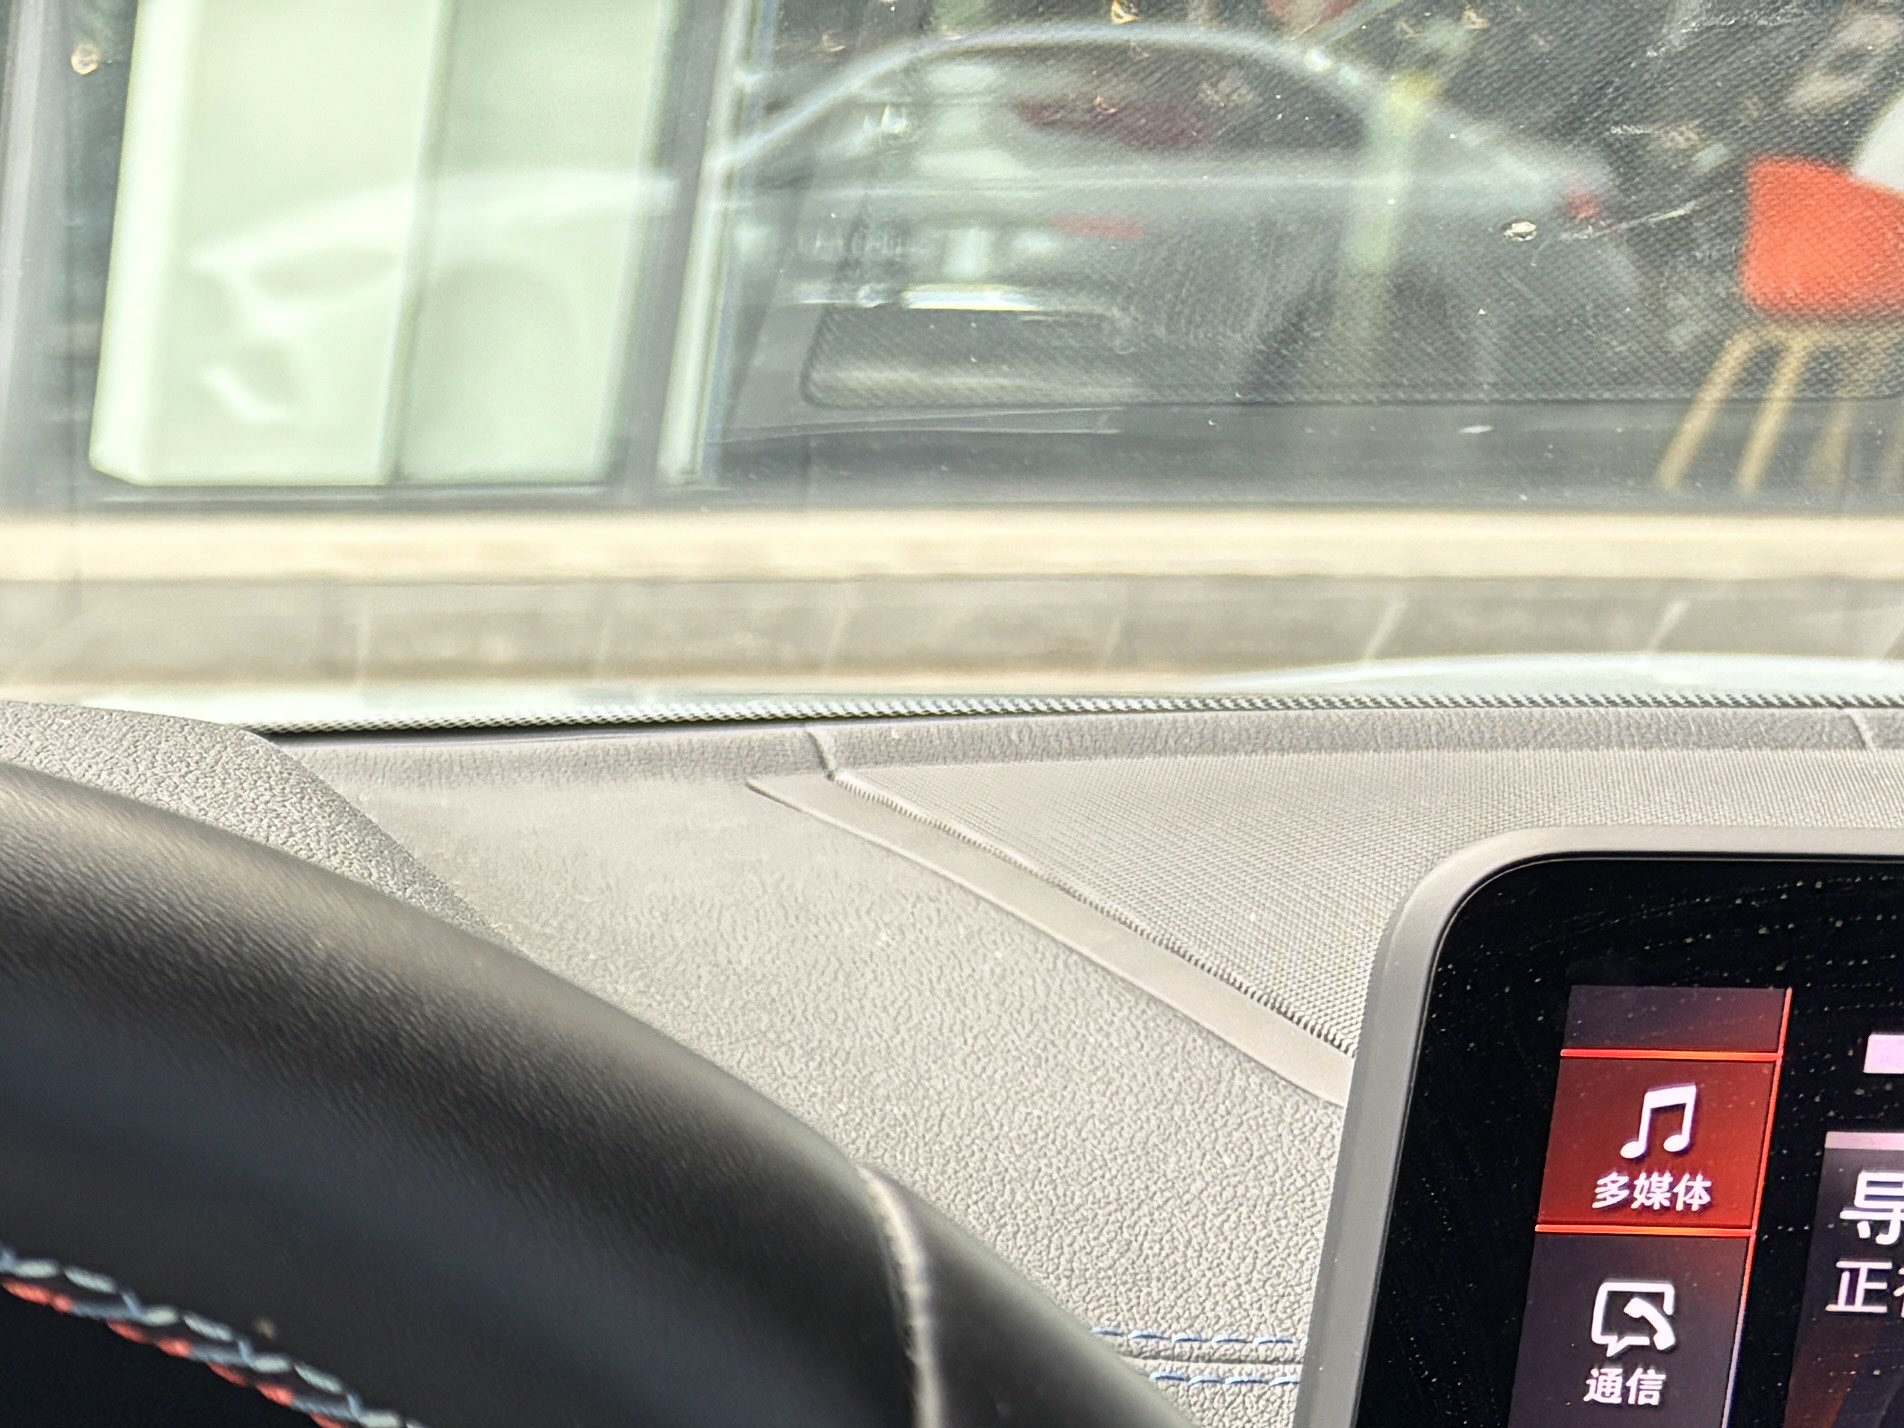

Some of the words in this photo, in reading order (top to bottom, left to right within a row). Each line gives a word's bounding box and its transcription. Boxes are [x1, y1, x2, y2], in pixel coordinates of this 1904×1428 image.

[1590, 1171, 1714, 1213] 多媒体
[1824, 1259, 1904, 1319] 正
[1582, 1366, 1667, 1406] 通信
